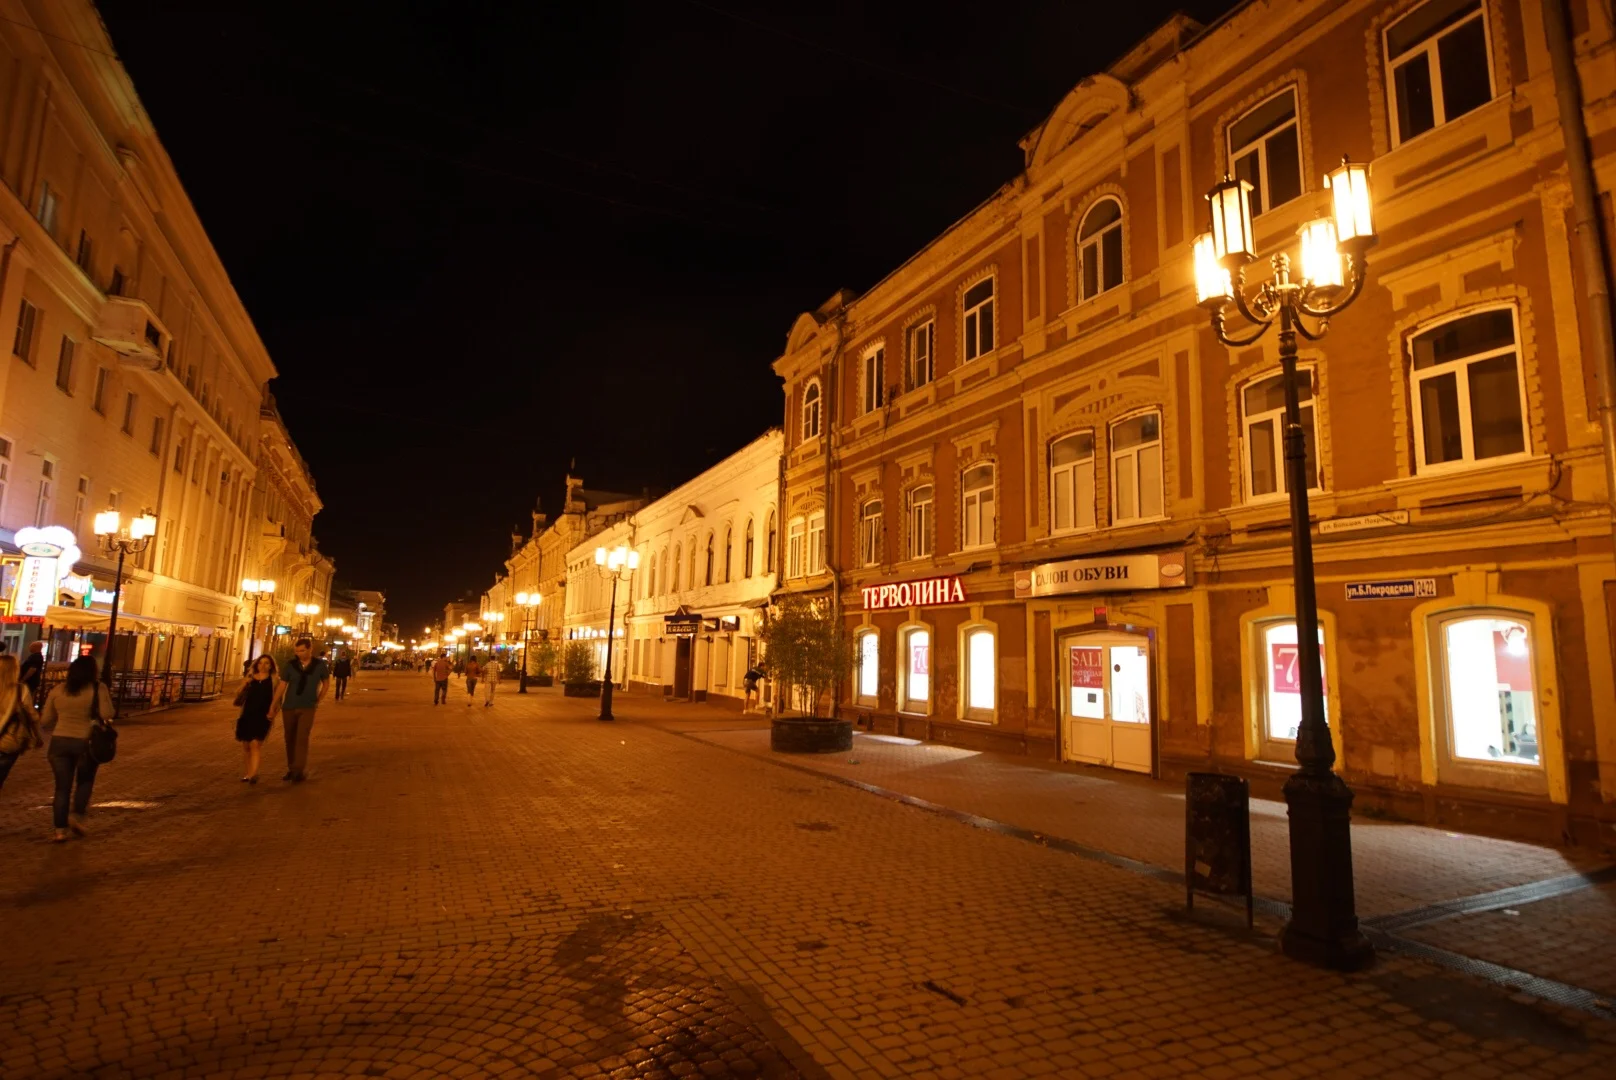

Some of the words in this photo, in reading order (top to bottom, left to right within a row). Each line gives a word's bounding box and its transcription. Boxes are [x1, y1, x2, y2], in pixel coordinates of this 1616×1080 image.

[1036, 570, 1068, 586] САЛОН
[1073, 565, 1129, 581] ОБУВИ
[861, 577, 965, 609] ТЕРВОЛИНА
